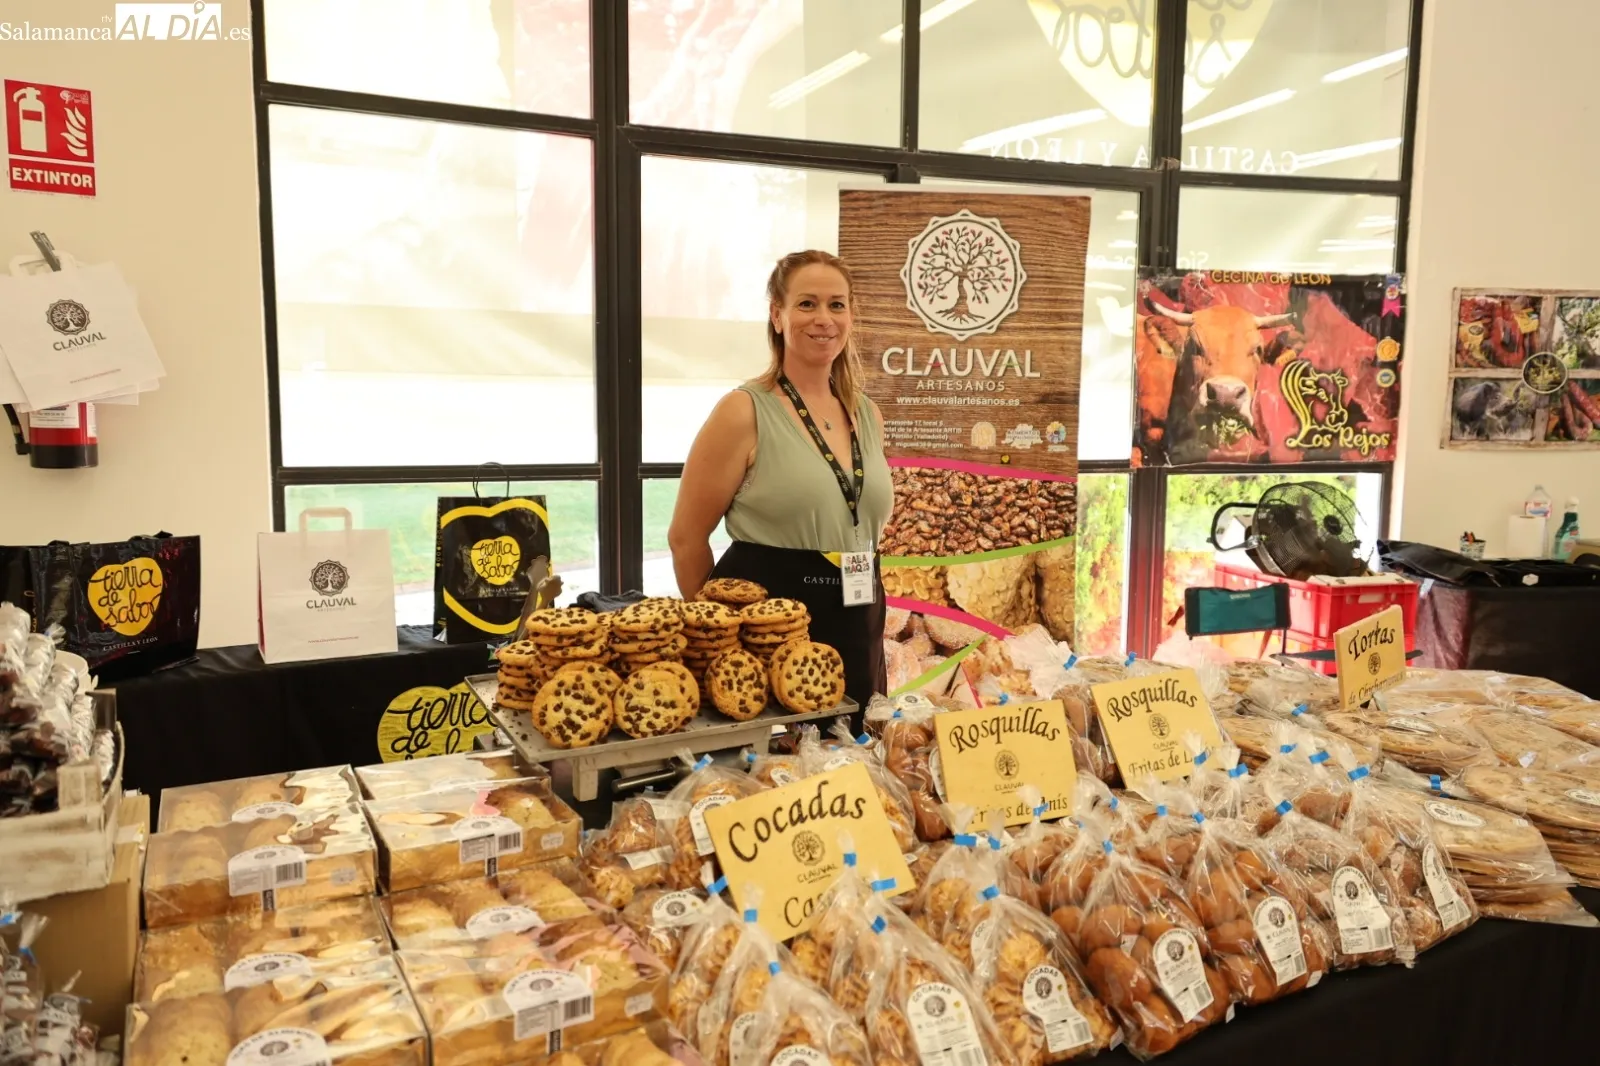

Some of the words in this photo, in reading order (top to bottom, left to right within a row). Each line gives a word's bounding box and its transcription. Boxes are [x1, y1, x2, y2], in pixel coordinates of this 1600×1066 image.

[12, 167, 93, 189] EXTINTOR
[1211, 270, 1264, 283] CECINA
[53, 332, 107, 352] CLAUVAL
[881, 347, 1041, 377] CLAUVAL
[916, 379, 1006, 392] ARTESANOS
[896, 396, 1020, 406] www.clauvalartesanos.es
[1339, 426, 1391, 455] Rejos
[471, 540, 520, 557] tierra
[89, 566, 162, 593] tierra
[98, 590, 122, 607] de
[104, 588, 162, 627] sabor
[306, 597, 357, 609] CLAUVAL
[1348, 620, 1396, 661] Tortas
[1107, 678, 1198, 722] Rosquillas
[949, 706, 1060, 754] Rosquillas
[1168, 750, 1181, 768] de
[728, 780, 866, 863] Cocadas
[797, 863, 838, 883] CLAUVAL
[1027, 967, 1059, 984] COCADAS
